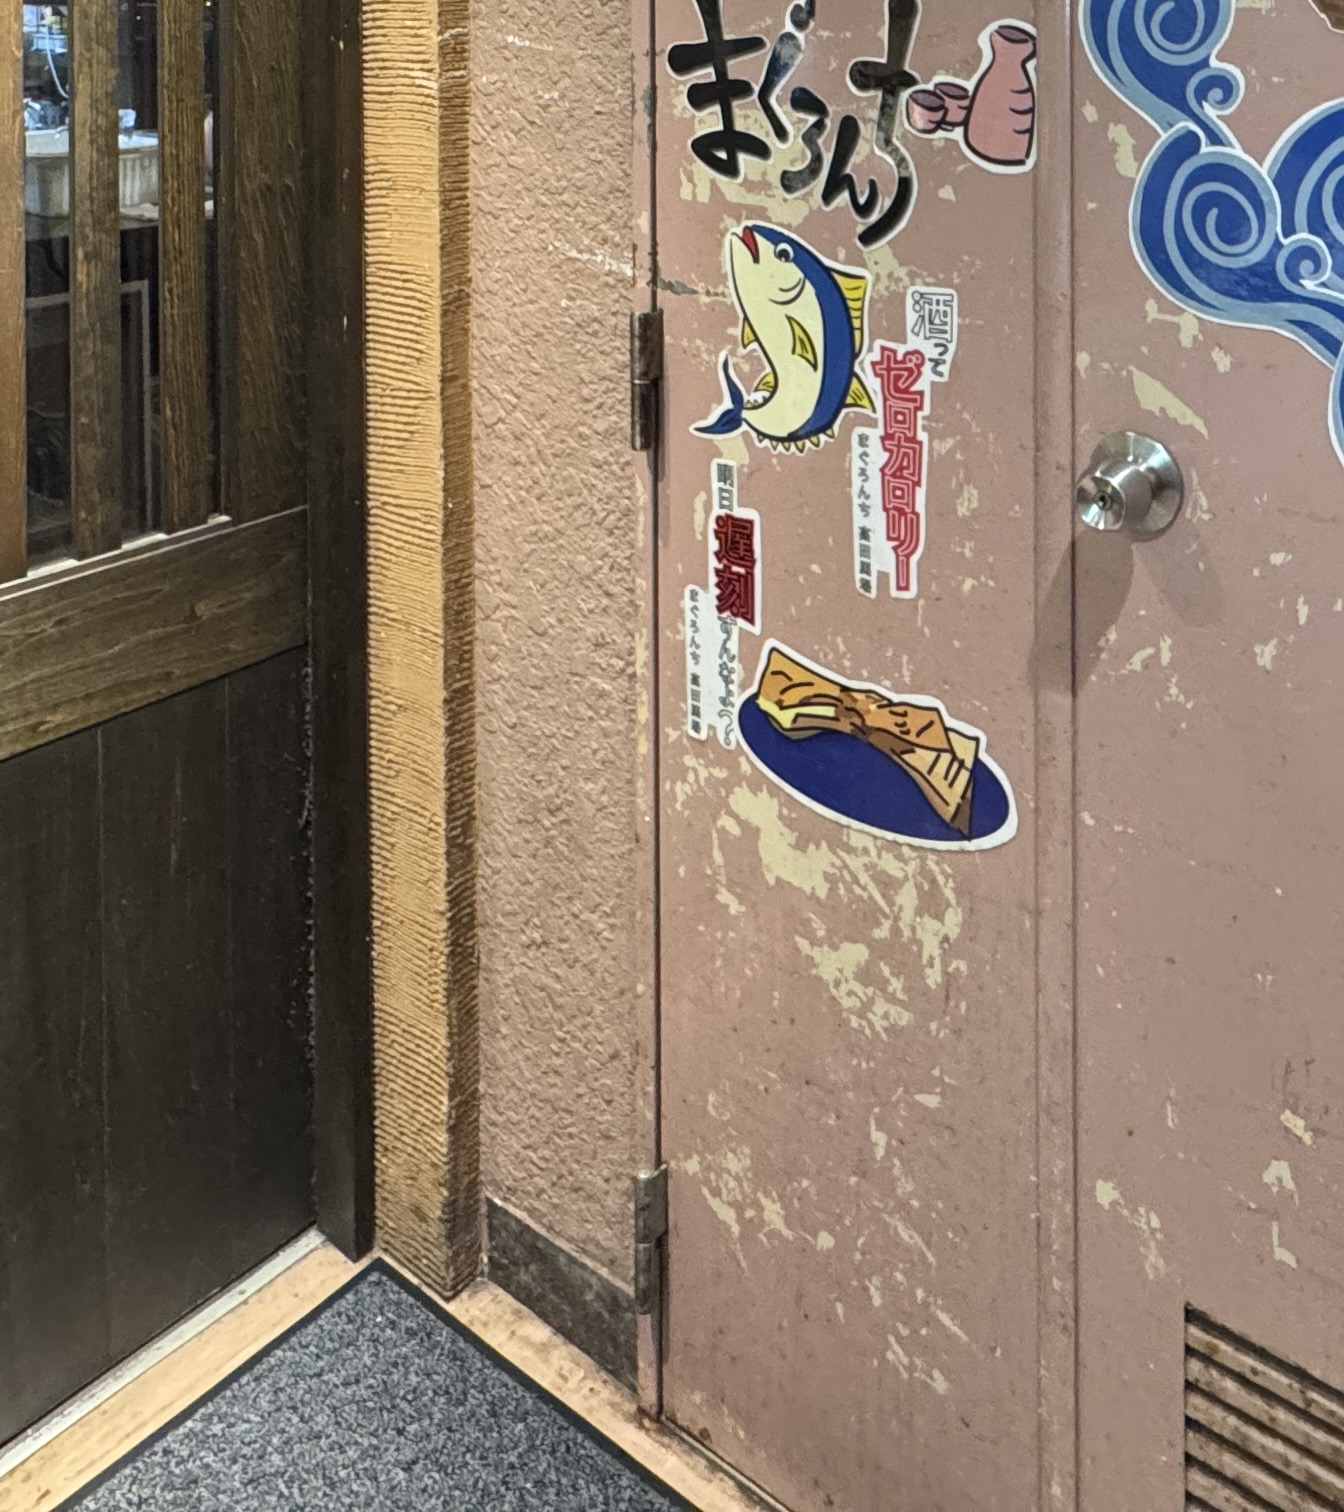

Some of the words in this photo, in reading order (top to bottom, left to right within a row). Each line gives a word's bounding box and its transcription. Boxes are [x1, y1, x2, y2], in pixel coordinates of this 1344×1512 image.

[911, 291, 954, 377] 酒って
[871, 345, 925, 592] ゼロカロリー
